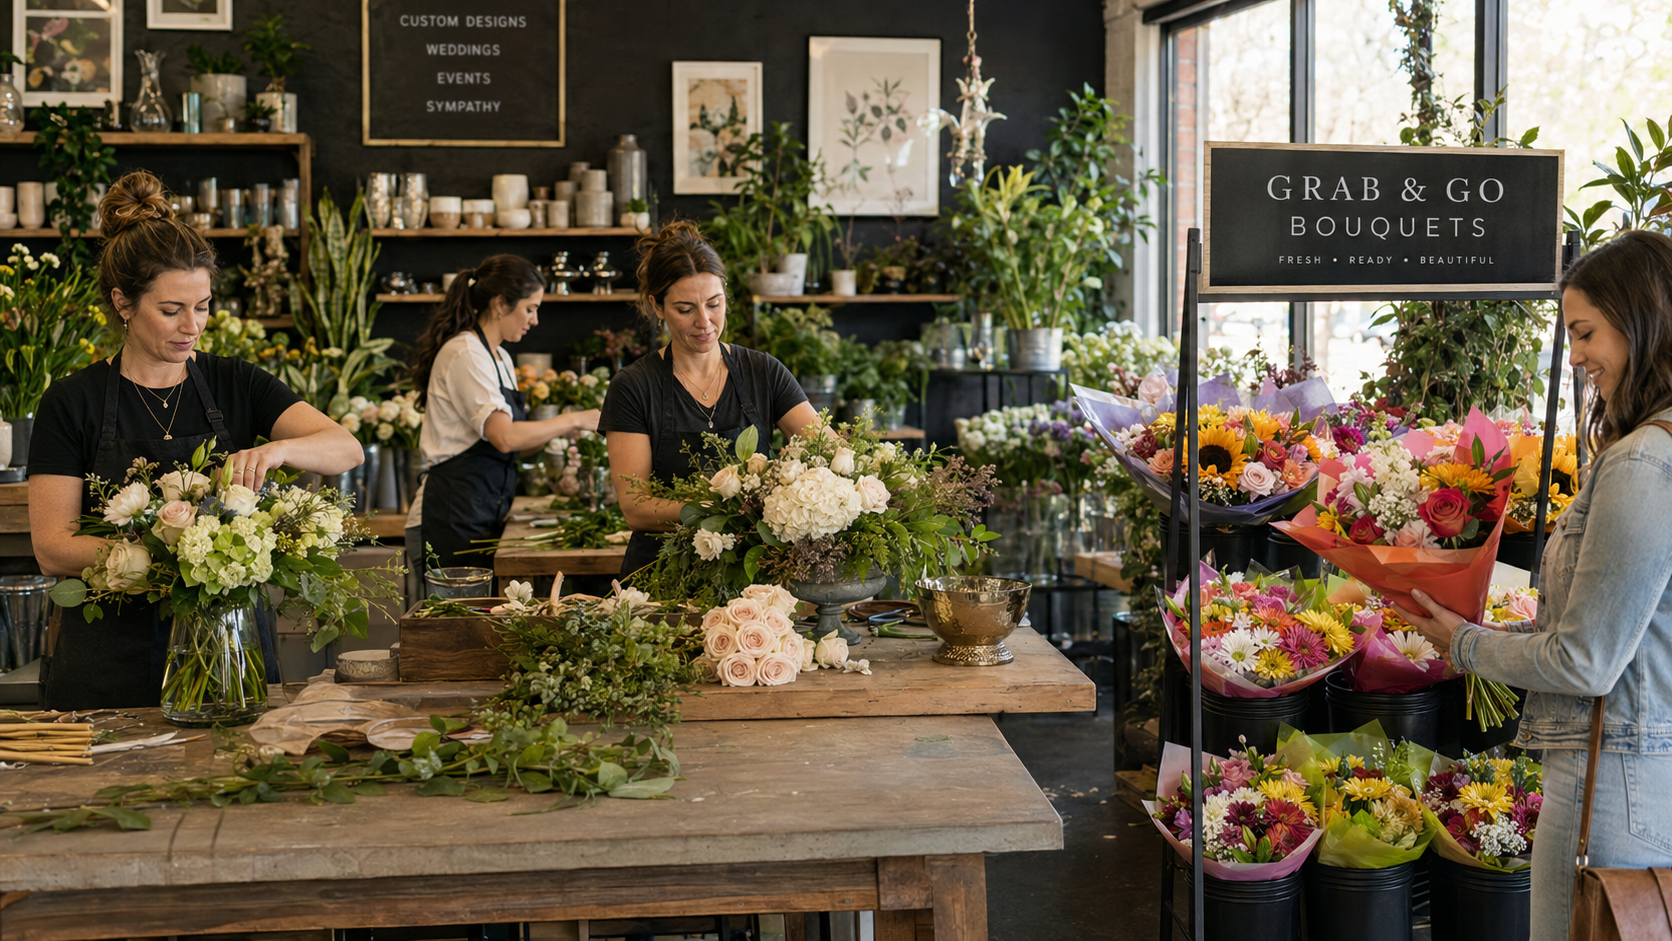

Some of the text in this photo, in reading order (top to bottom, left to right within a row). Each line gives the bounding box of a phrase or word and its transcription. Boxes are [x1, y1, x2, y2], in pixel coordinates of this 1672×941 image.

[400, 15, 527, 28] CUSTOM DESIGNS
[426, 43, 501, 56] WEDDINGS
[437, 72, 491, 85] EVENTS
[426, 100, 501, 113] SYMPATHY
[1266, 174, 1504, 204] GRAB & GO
[1290, 216, 1486, 241] BOUQUETS
[1278, 255, 1495, 265] FRESH READY BEAUTIFUL
